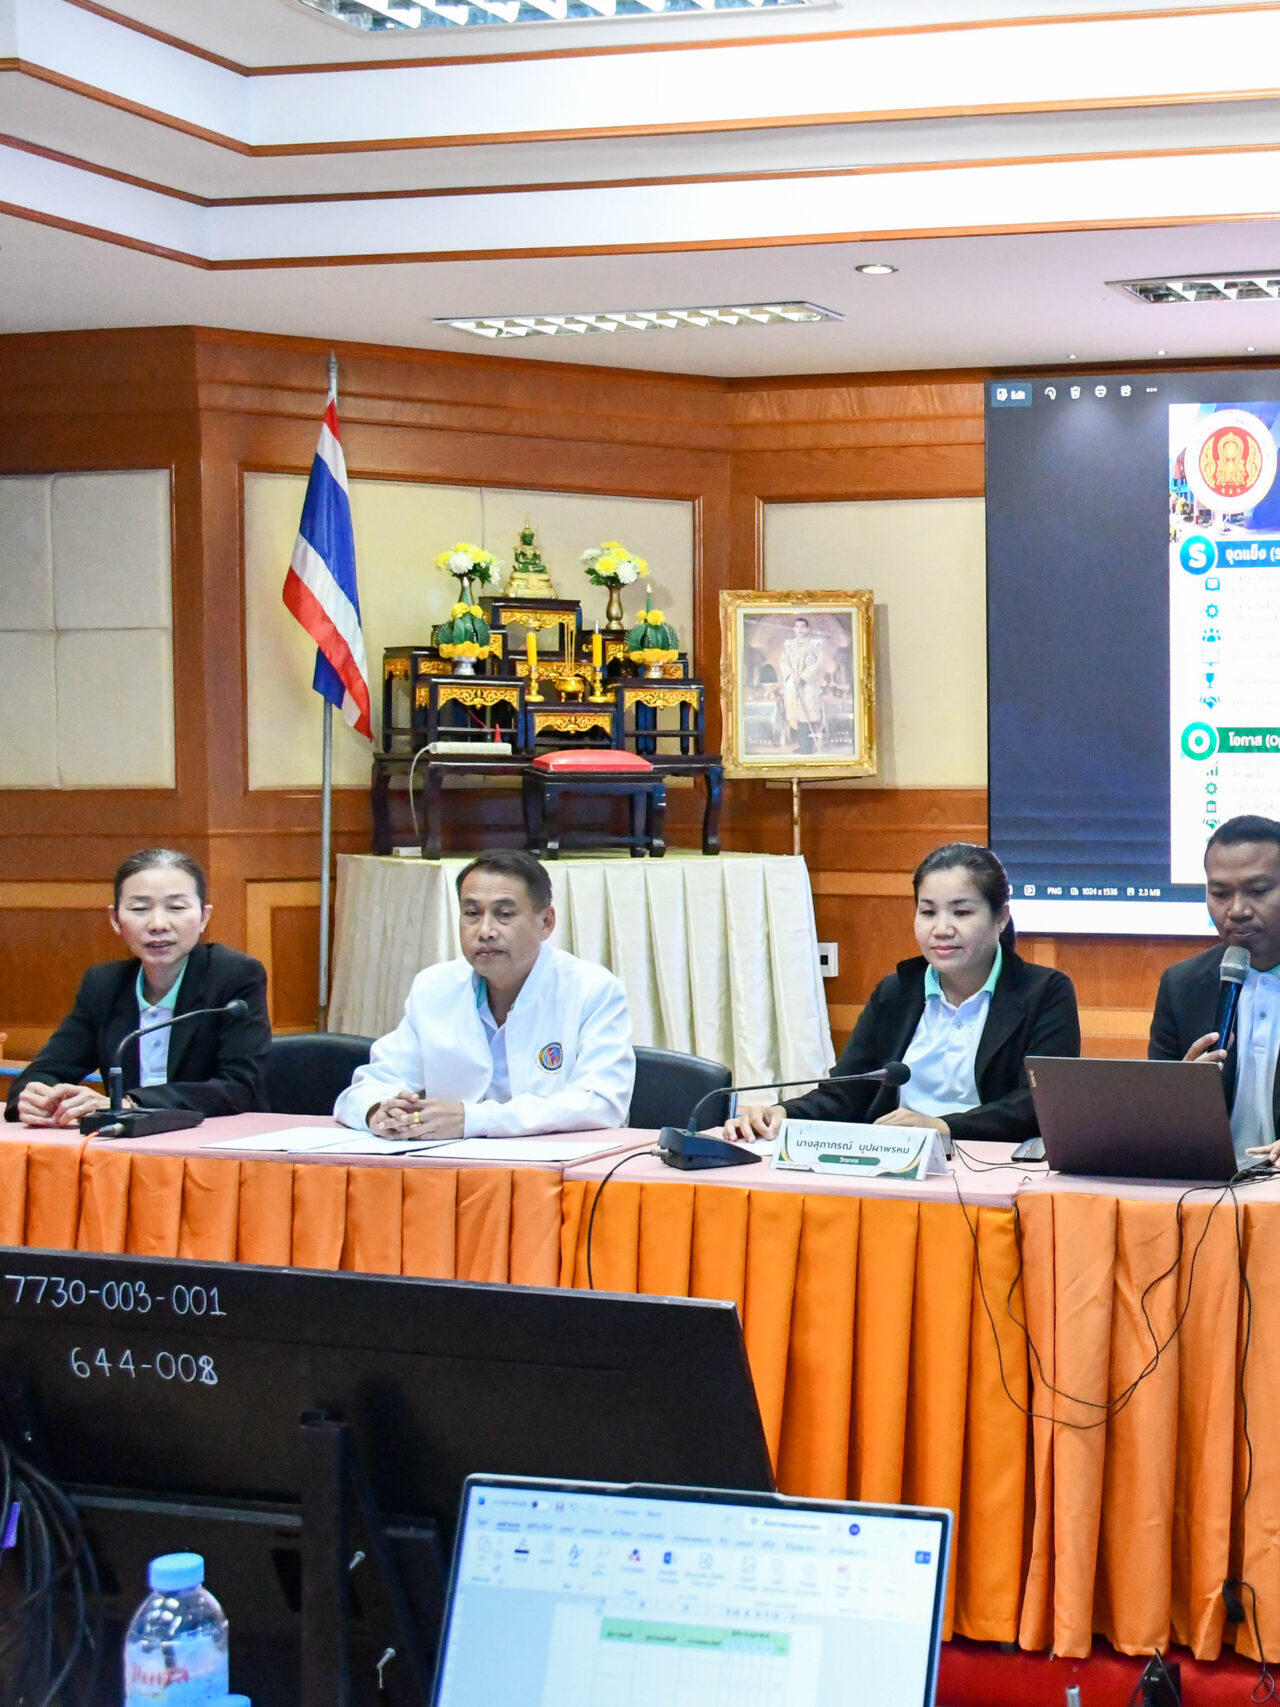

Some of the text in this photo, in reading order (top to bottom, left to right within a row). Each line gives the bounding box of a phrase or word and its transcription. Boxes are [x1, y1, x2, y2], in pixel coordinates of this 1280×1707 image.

[1188, 542, 1207, 569] S
[1225, 543, 1267, 565] จุดแข็ง
[1188, 729, 1211, 753] O
[1228, 731, 1263, 747] โอกาส
[1047, 886, 1063, 896] PNG
[1082, 887, 1098, 896] 1024
[1138, 888, 1149, 897] 2.3
[1149, 888, 1161, 897] MB
[4, 1274, 228, 1316] 7730-003-001
[70, 1346, 219, 1386] 644-008
